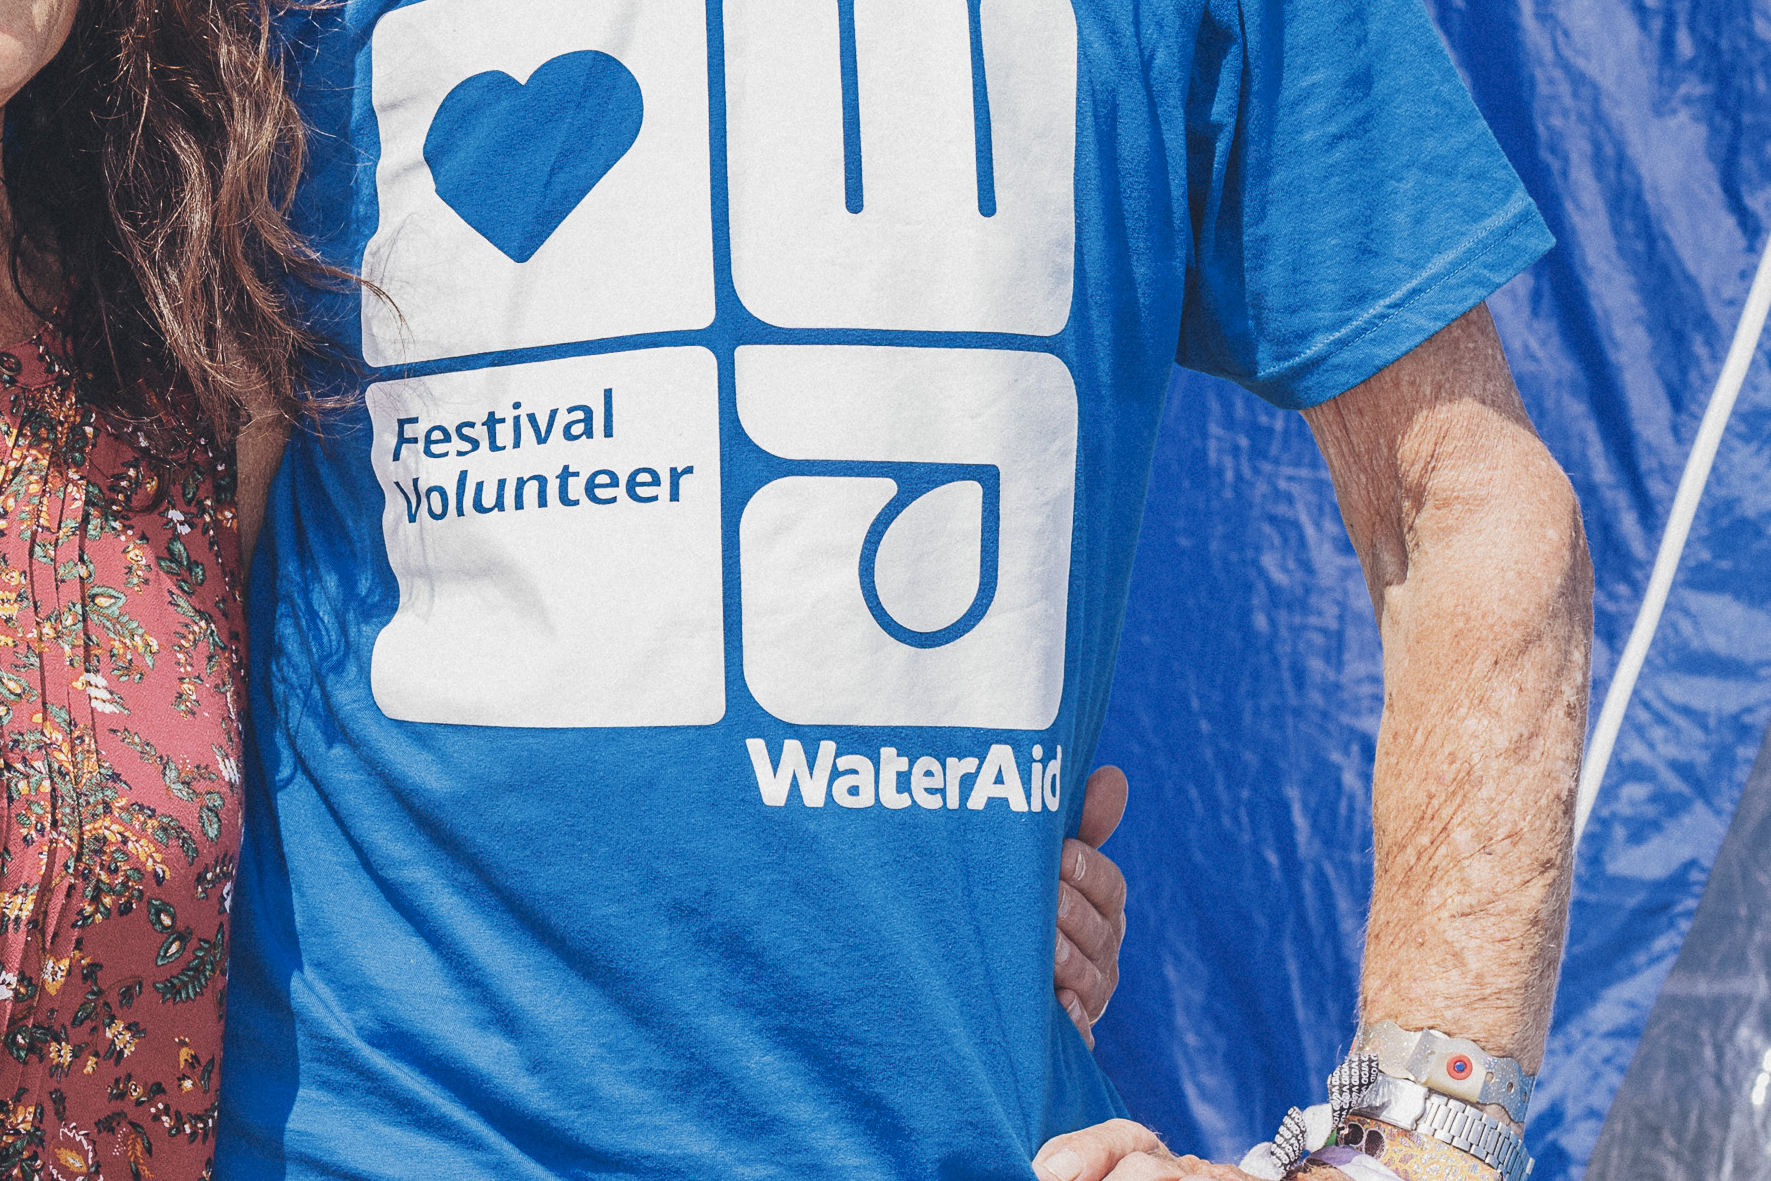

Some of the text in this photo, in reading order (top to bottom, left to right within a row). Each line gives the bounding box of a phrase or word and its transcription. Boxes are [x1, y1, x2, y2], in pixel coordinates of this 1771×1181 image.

[392, 388, 615, 462] Festival
[393, 464, 694, 524] Volunteer
[745, 737, 1063, 813] WaterAid
